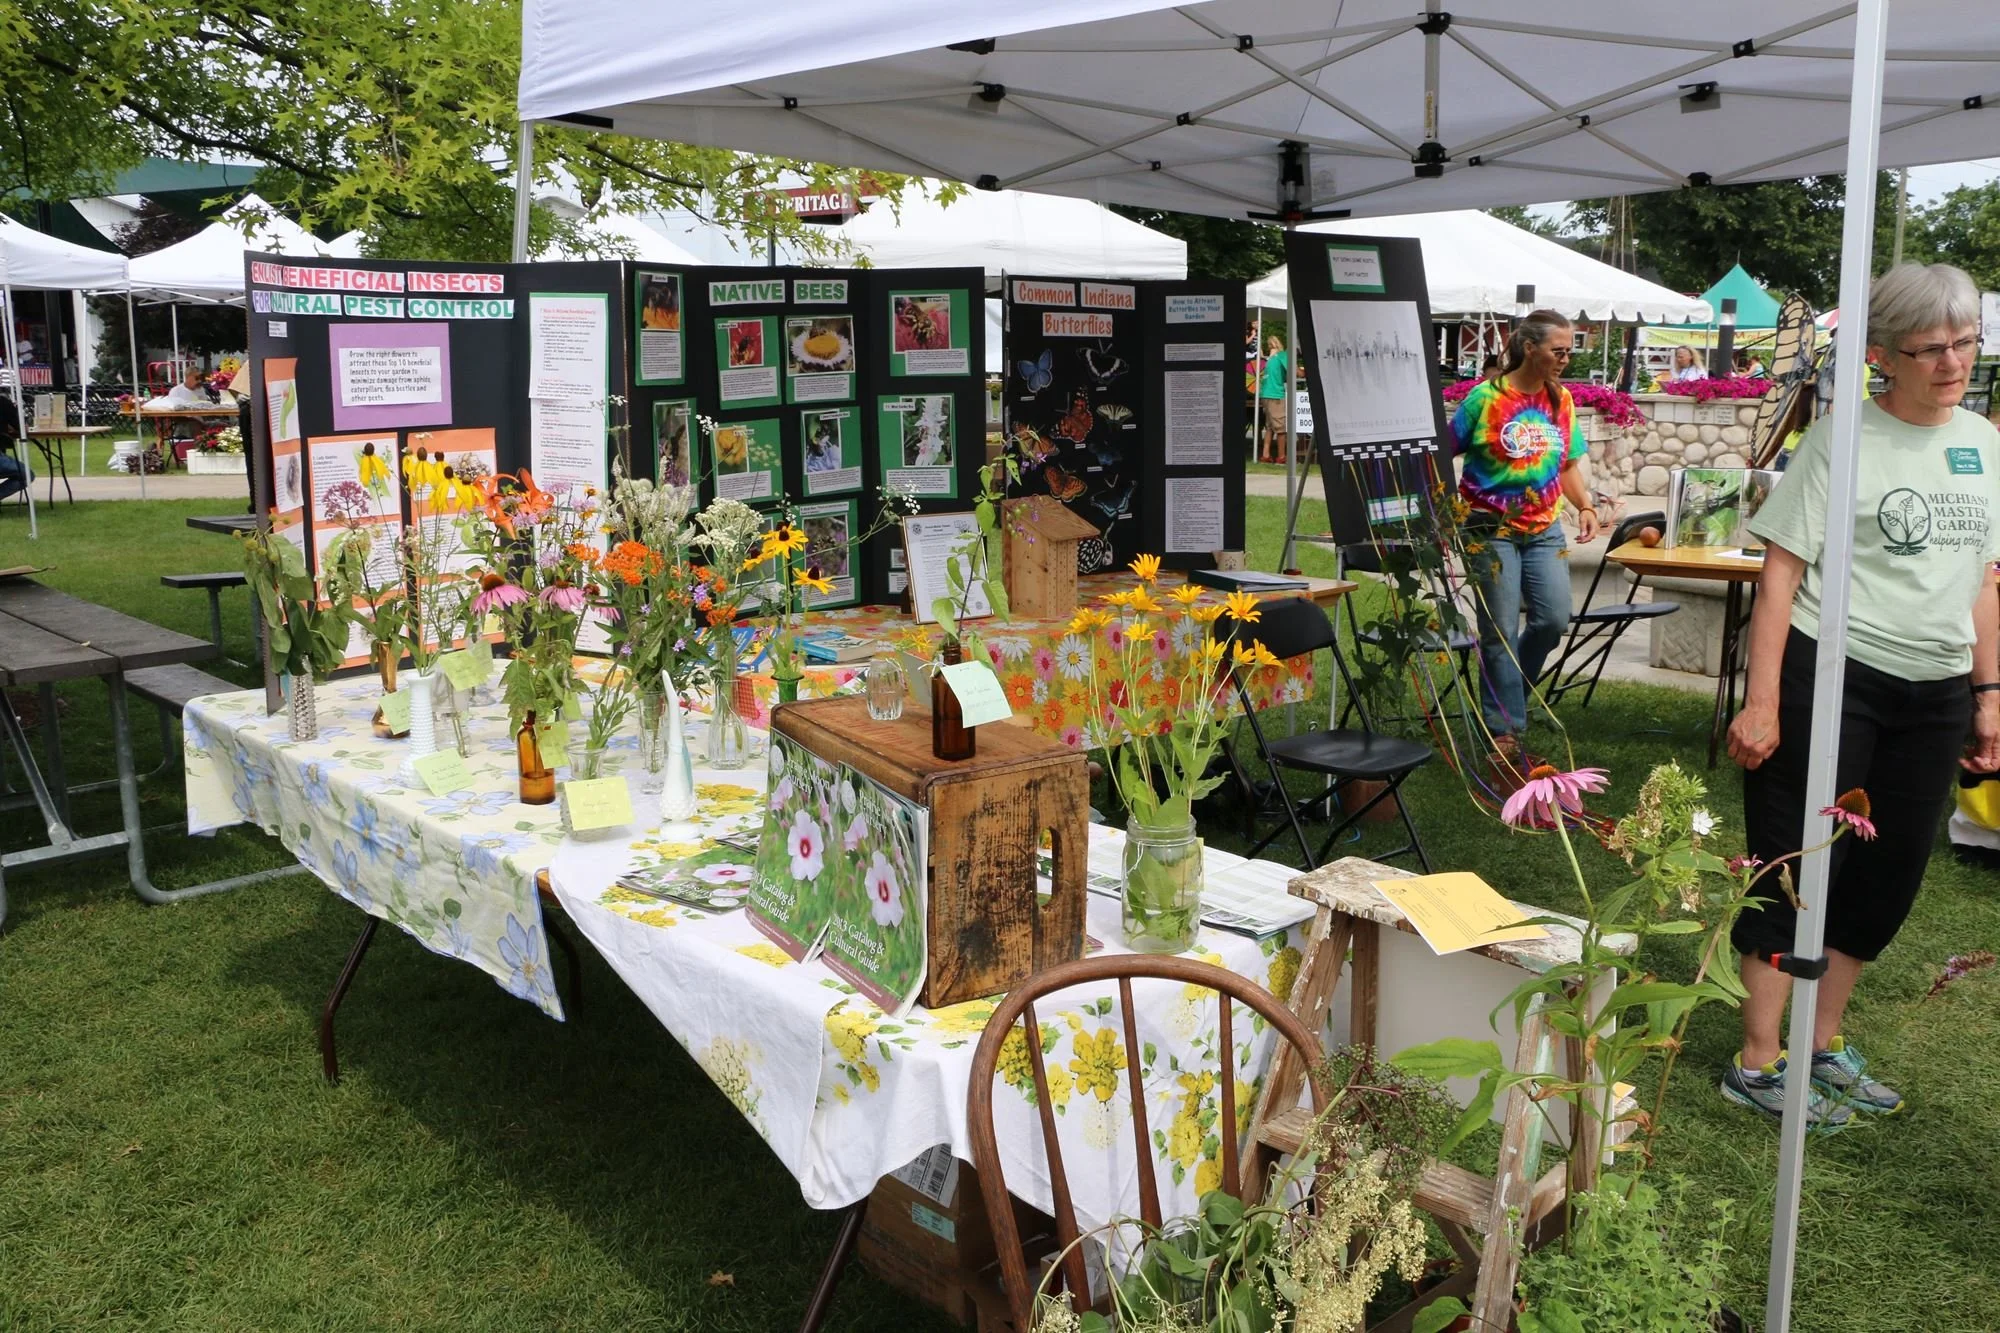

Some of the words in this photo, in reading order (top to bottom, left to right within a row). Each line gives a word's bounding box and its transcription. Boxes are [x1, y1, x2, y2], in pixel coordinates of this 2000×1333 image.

[253, 262, 282, 284] ENLIST
[282, 266, 402, 291] BENEFICIAL
[408, 272, 503, 292] INSECTS
[713, 283, 783, 302] NATIVE
[796, 282, 845, 300] BEES
[1019, 282, 1073, 304] Common
[1084, 286, 1133, 308] Indiana
[253, 290, 271, 313] FOR
[271, 291, 339, 314] NATURAL
[345, 297, 402, 316] PEST
[409, 299, 513, 318] CONTROL
[1044, 314, 1112, 335] Butterflies
[349, 350, 364, 358] Grow
[365, 350, 375, 358] the
[376, 351, 390, 359] right
[391, 350, 411, 358] flowers
[392, 368, 411, 376] garden
[351, 394, 367, 402] other
[1300, 395, 1309, 404] GR
[1297, 407, 1312, 415] OMM
[1300, 419, 1313, 427] BOO
[1936, 519, 1986, 533] GARDE
[1929, 532, 1961, 552] helping
[859, 788, 881, 817] Prairie
[762, 877, 789, 906] Catalog
[787, 894, 796, 909] &
[768, 901, 790, 923] Guide
[848, 924, 877, 954] Catalog
[876, 942, 885, 956] &
[829, 930, 858, 959] Cultural
[857, 949, 880, 973] Guide
